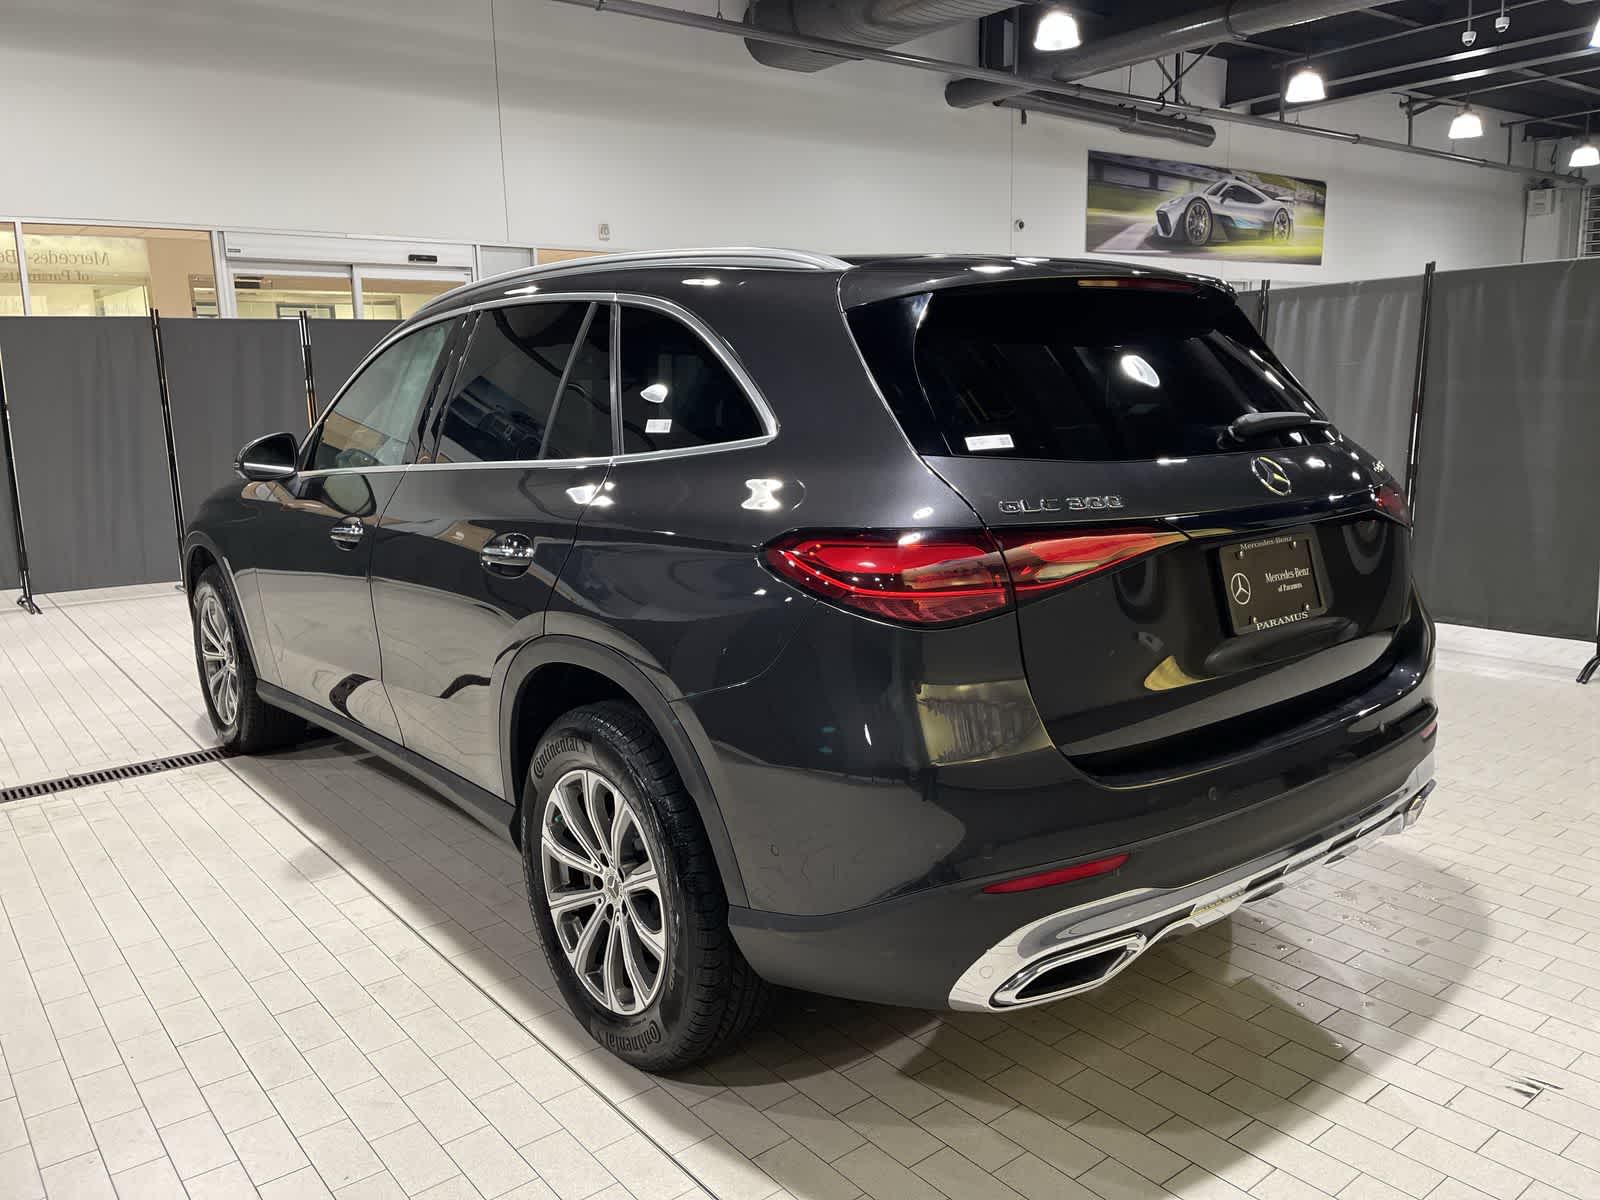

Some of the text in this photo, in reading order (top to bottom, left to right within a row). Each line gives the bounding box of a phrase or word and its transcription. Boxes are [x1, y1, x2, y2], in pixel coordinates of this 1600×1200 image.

[998, 495, 1124, 513] GLC 300
[1256, 611, 1309, 631] PARAMUS
[533, 736, 579, 779] Continental
[606, 1019, 661, 1054] Continental
